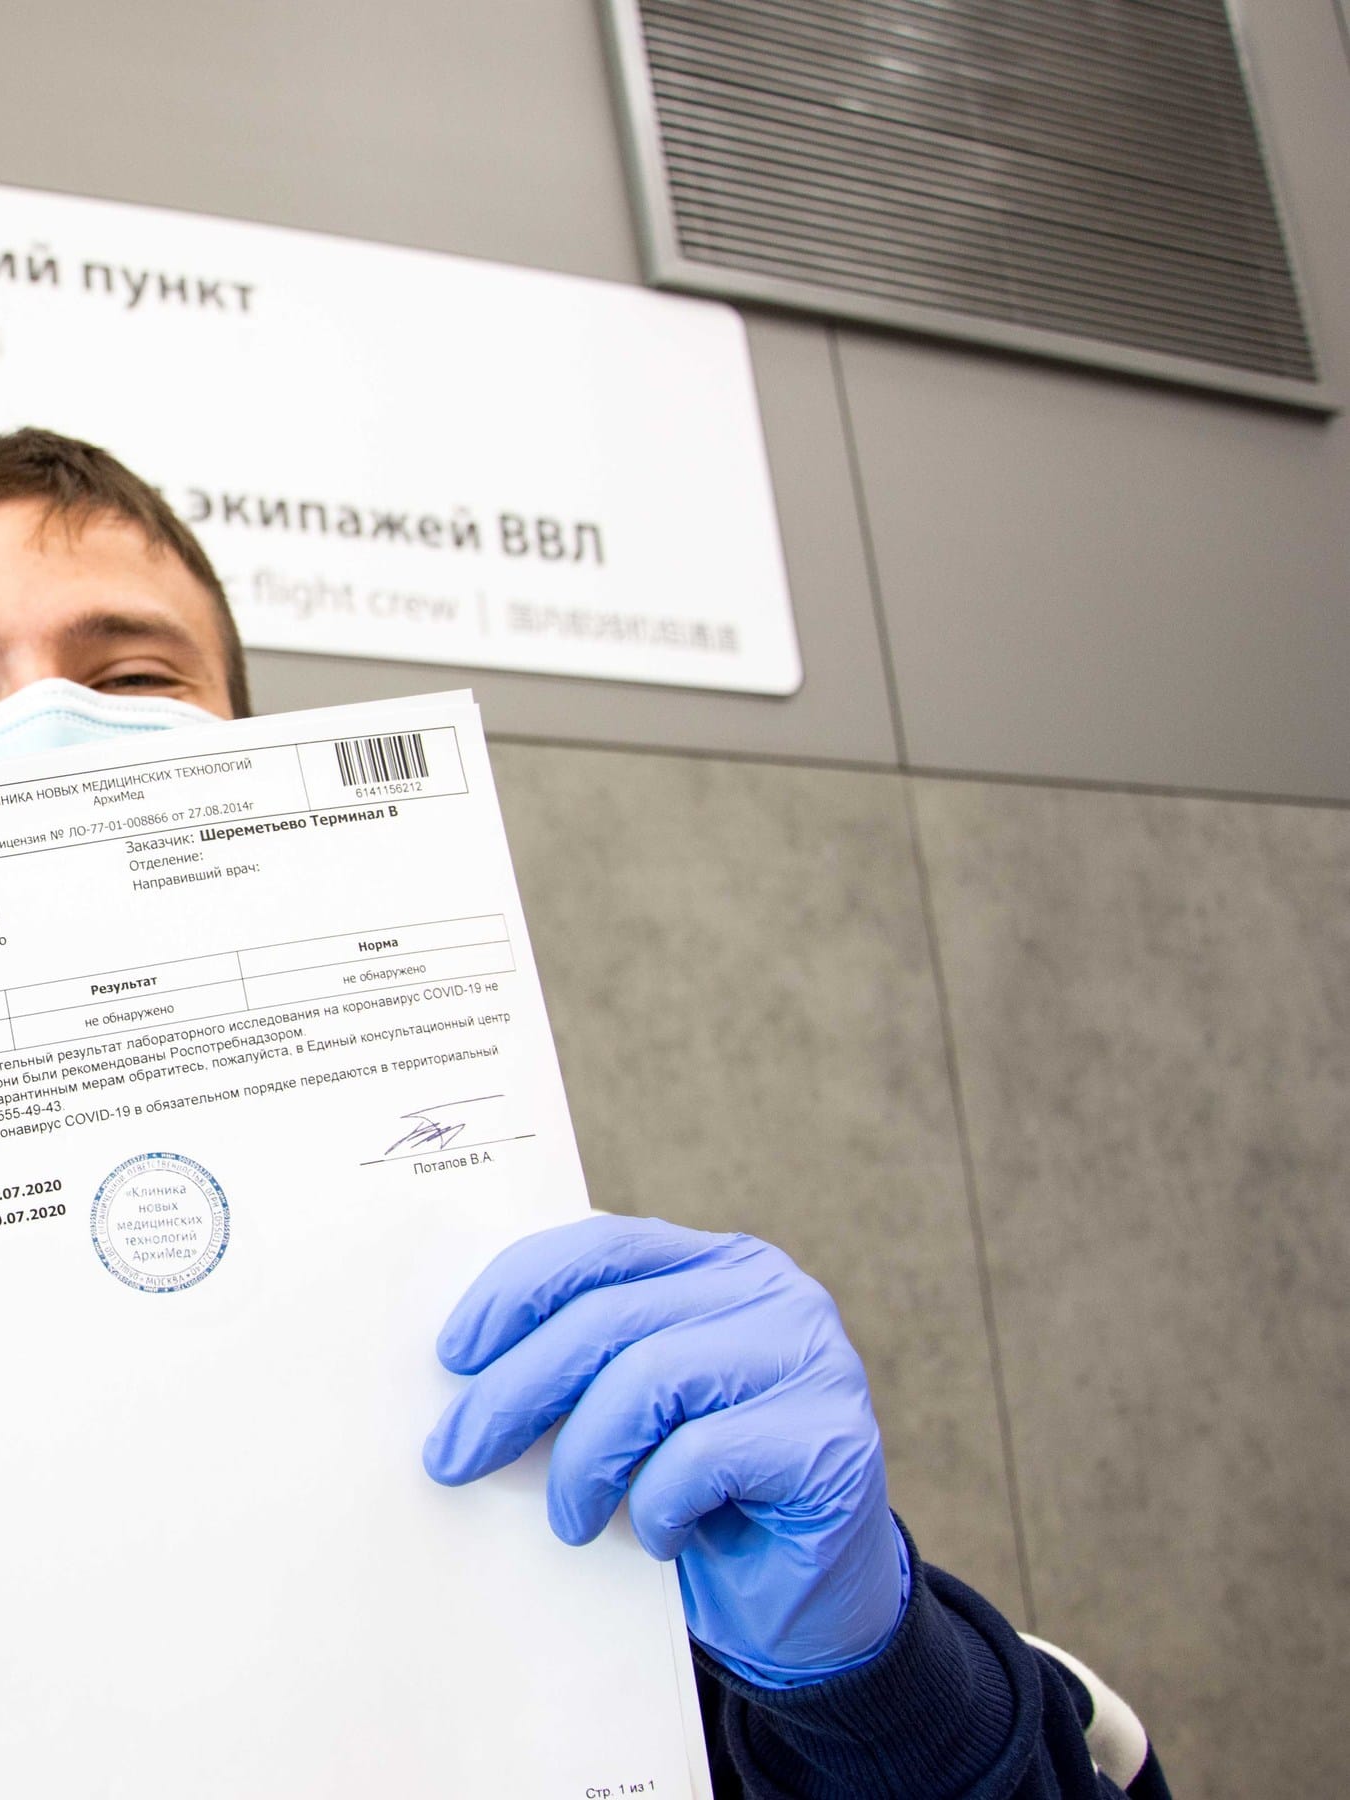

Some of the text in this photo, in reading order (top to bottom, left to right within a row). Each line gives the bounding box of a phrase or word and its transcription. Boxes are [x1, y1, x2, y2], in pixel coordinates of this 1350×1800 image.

[83, 261, 256, 315] пункт
[187, 487, 606, 564] экипажей ВВЛ
[251, 572, 459, 622] flight crew
[36, 784, 80, 800] НОВЫХ
[82, 770, 172, 793] МЕДИЦИНСКИХ
[174, 757, 253, 778] ТЕХНОЛОГИЙ
[355, 781, 423, 799] 6141156212
[93, 790, 145, 807] АрхиМед
[69, 812, 169, 838] ЛО-77-01-008866
[171, 811, 185, 822] от
[188, 801, 254, 819] 27.08.2014г
[125, 834, 195, 854] Заказчик:
[199, 818, 307, 842] Шереметьево
[309, 809, 385, 827] Терминал
[129, 851, 204, 872] Отделение:
[132, 863, 261, 891] Направивший врач:
[358, 939, 399, 953] Норма
[90, 976, 157, 996] Результат
[342, 964, 427, 985] не обнаружено
[57, 1042, 122, 1064] результат
[126, 1024, 226, 1050] лабораторного
[228, 1008, 321, 1032] исследования
[323, 1005, 340, 1016] на
[342, 993, 421, 1014] коронавирус
[423, 982, 482, 1001] COVID-19
[484, 982, 499, 992] не
[84, 1004, 175, 1028] не обнаружено
[81, 1074, 126, 1091] мерам
[295, 1044, 304, 1054] в
[306, 1034, 357, 1052] Единый
[360, 1015, 475, 1043] консультационный
[477, 1012, 511, 1026] центр
[22, 1069, 58, 1084] были
[61, 1051, 166, 1080] рекомендованы
[64, 1105, 131, 1127] COVID-19
[134, 1105, 143, 1116] в
[145, 1088, 240, 1113] обязательном
[243, 1079, 297, 1097] порядке
[300, 1065, 378, 1087] передаются
[380, 1063, 389, 1073] в
[391, 1044, 499, 1072] территориальный
[413, 1157, 468, 1175] Потапов
[139, 1202, 179, 1213] новых
[117, 1215, 202, 1231] медицинских
[126, 1230, 197, 1246] технологий
[586, 1780, 655, 1799] Стр. 1 из 1
